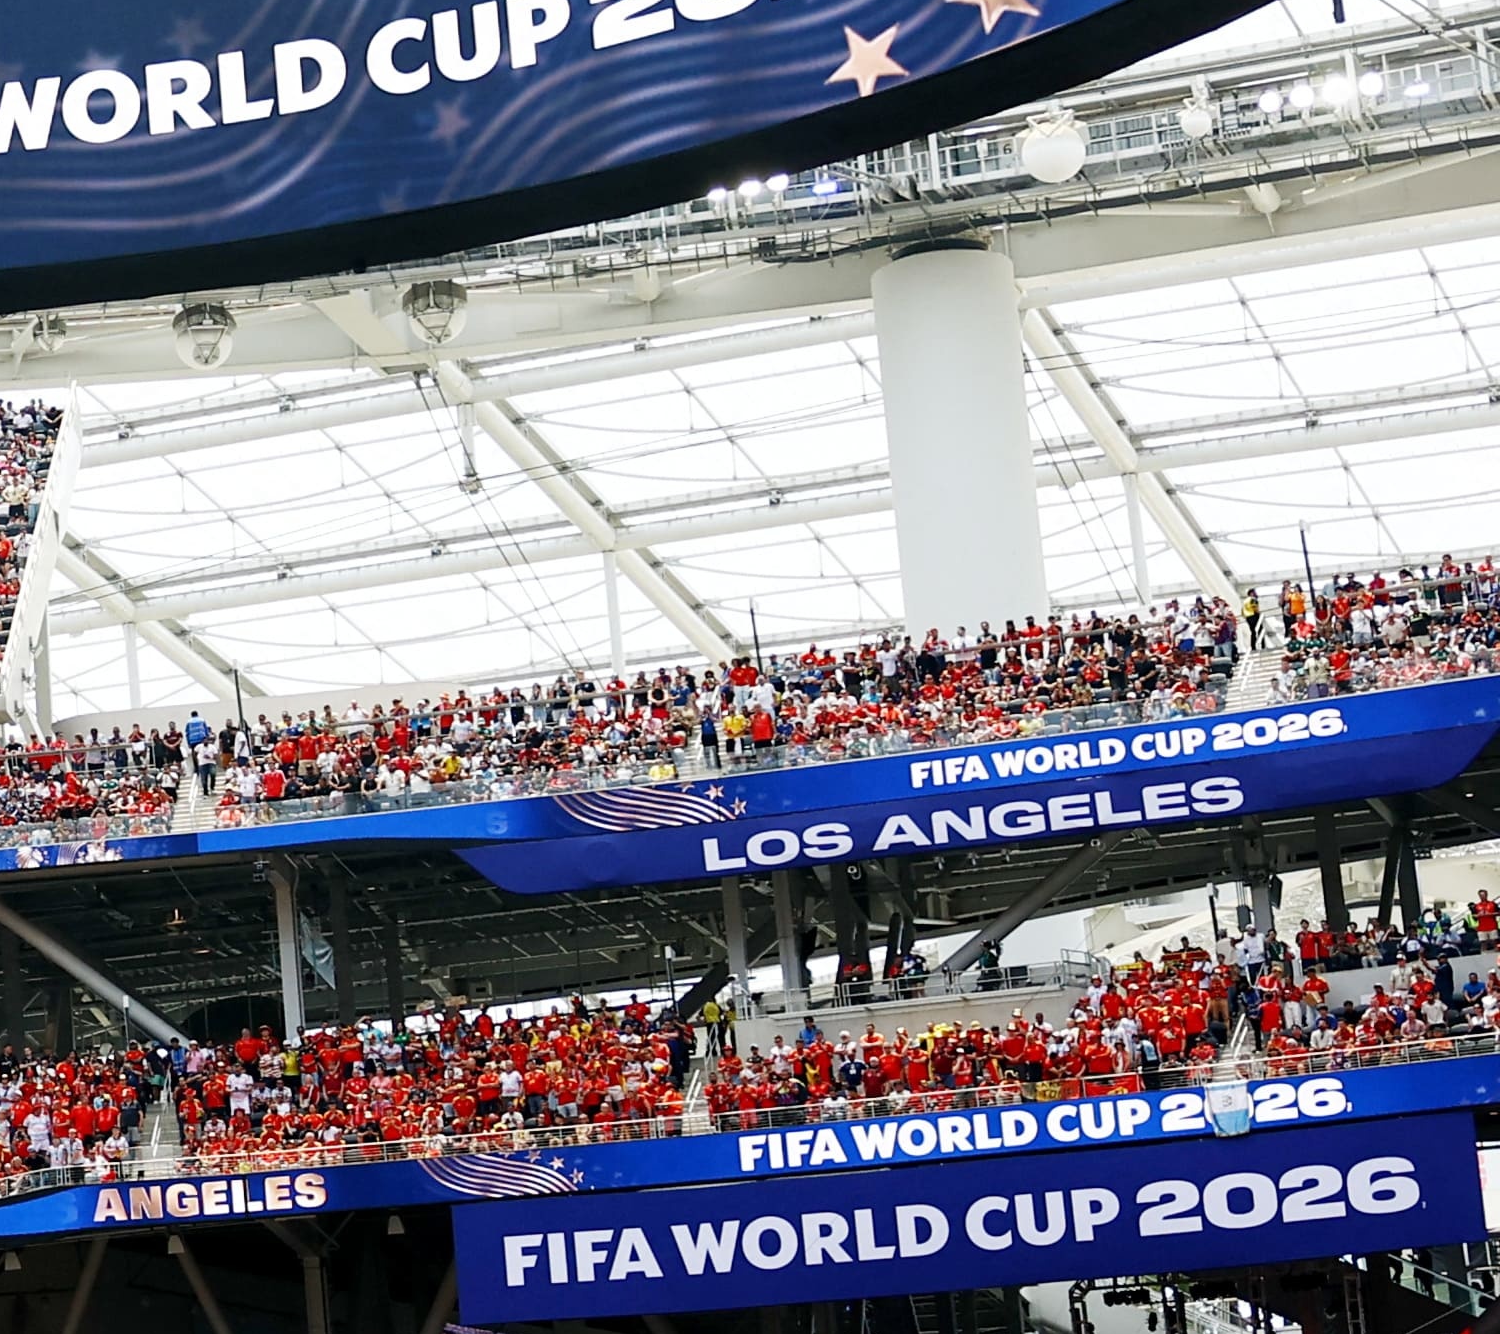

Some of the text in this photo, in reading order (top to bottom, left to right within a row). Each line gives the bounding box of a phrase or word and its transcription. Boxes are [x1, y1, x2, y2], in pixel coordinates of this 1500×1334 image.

[911, 710, 1344, 788] FIFA WORLD CUP 2026
[703, 777, 1243, 871] LOS ANGELES
[738, 1078, 1346, 1171] FIFA WORLD CUP 226
[93, 1172, 326, 1222] ANGELES
[504, 1157, 1419, 1286] FIFA WORLD CUP 2026
